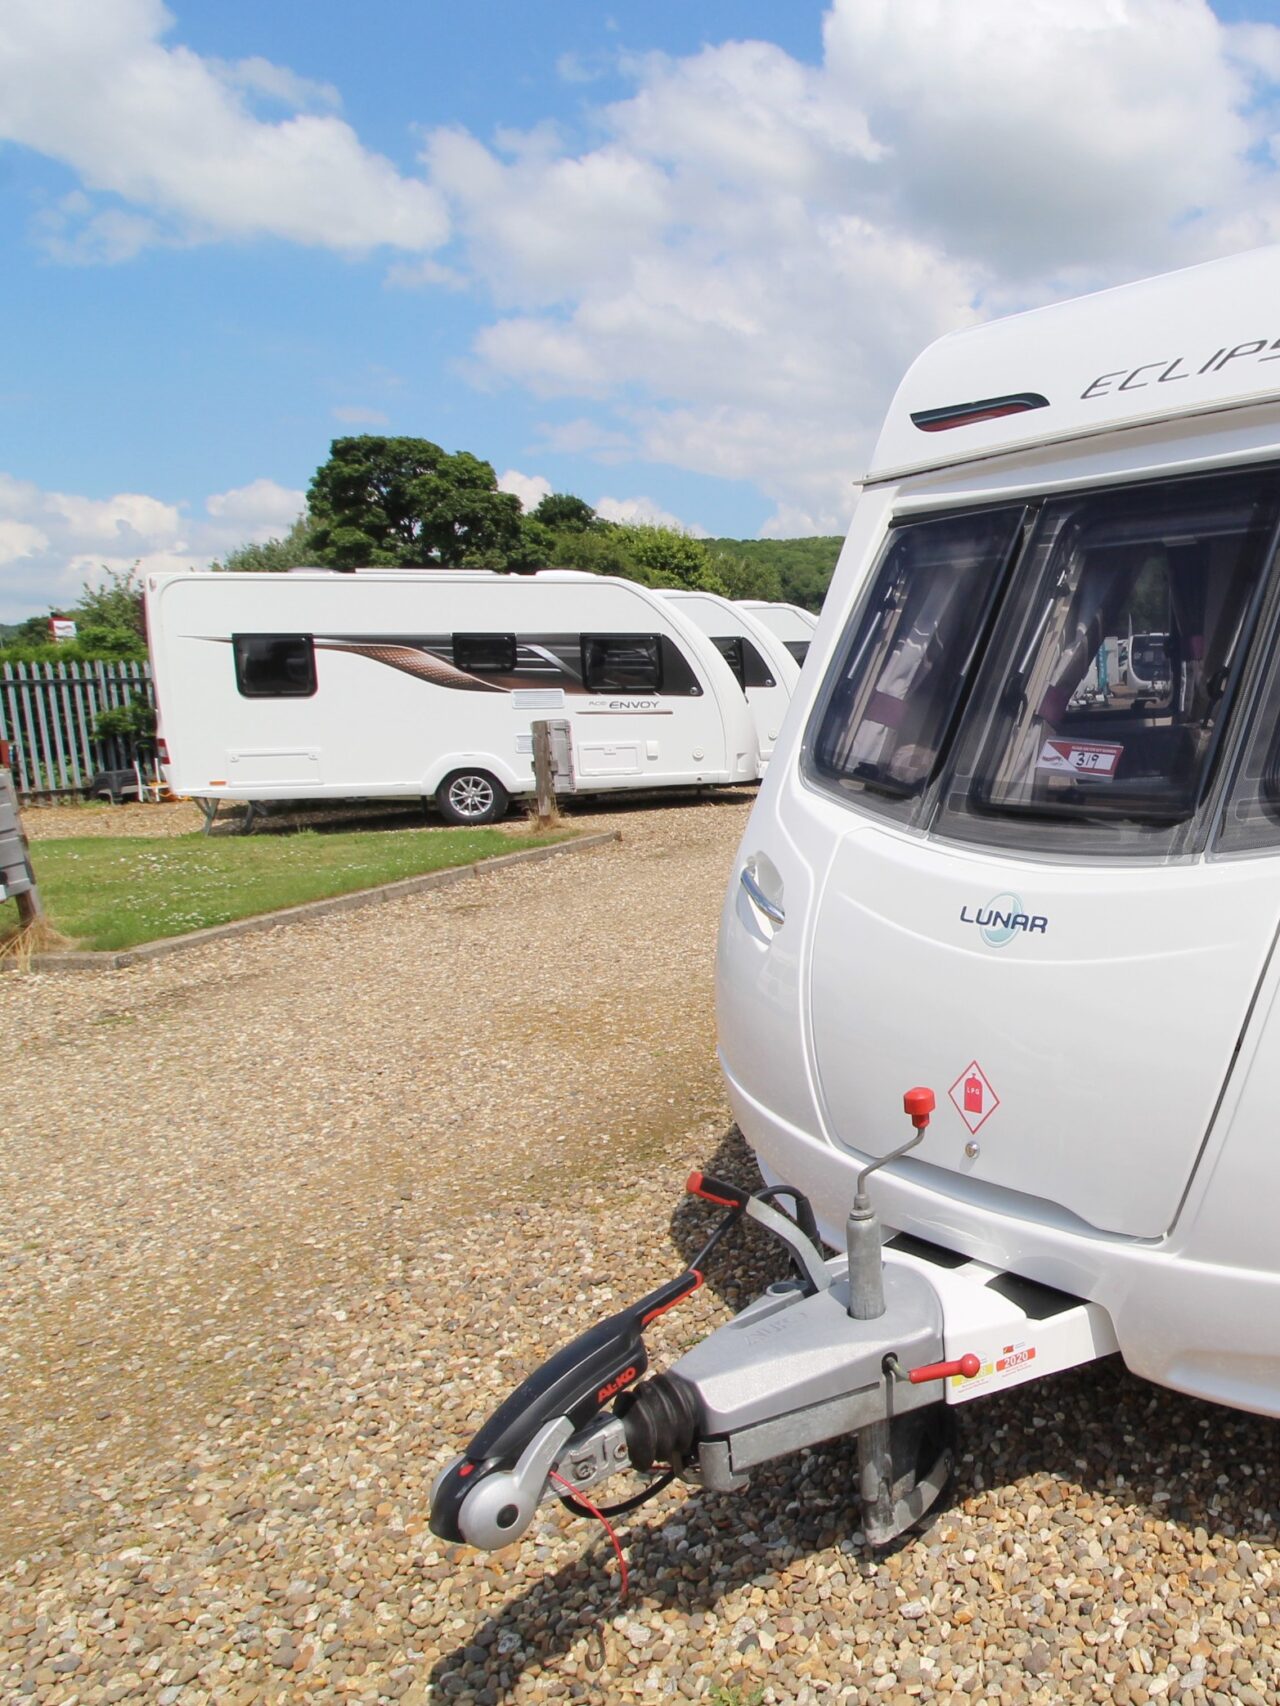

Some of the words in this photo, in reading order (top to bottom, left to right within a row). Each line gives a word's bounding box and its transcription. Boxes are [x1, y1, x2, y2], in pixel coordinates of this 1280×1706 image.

[609, 701, 659, 709] ENVOY
[960, 905, 1048, 933] LUNAR
[967, 1087, 980, 1095] LPG
[1003, 1351, 1029, 1368] 2020
